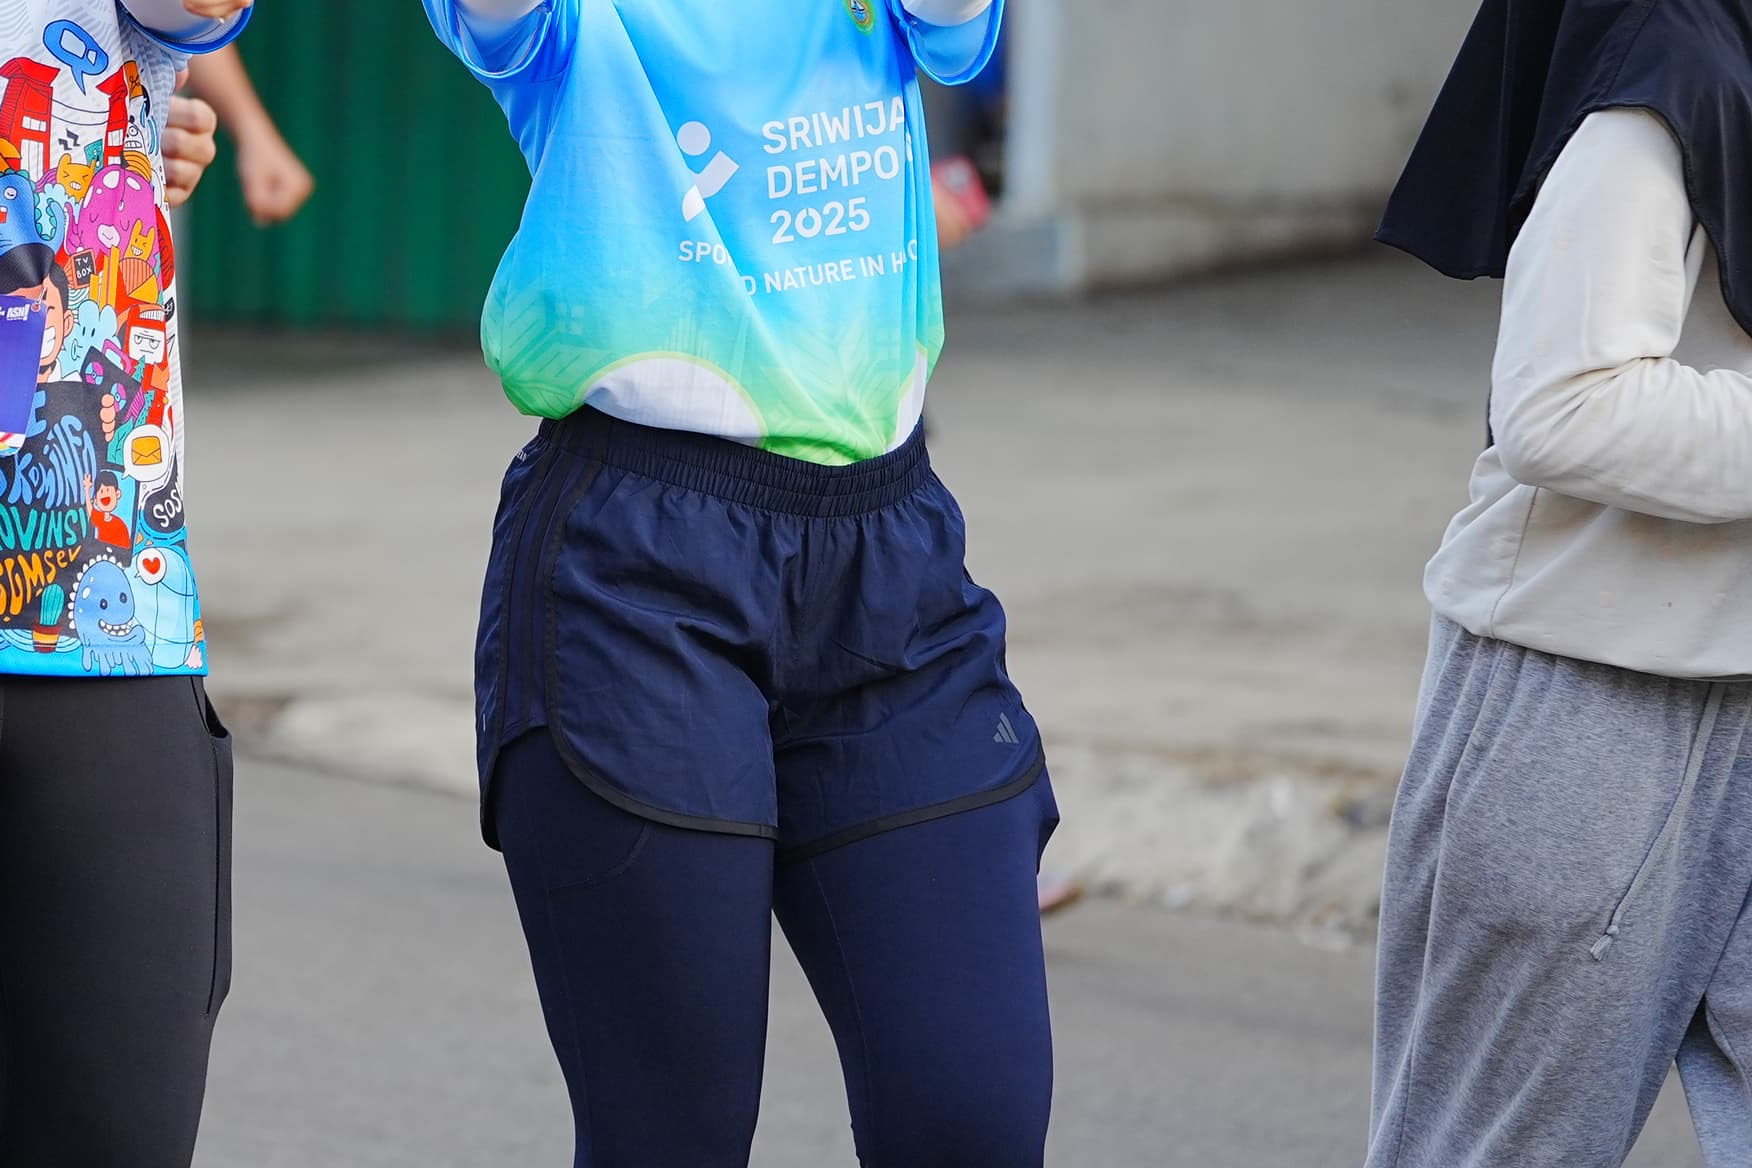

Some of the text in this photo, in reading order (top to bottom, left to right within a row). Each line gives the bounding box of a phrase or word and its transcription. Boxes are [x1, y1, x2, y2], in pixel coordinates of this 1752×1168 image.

[767, 145, 899, 200] DEMPO
[769, 197, 870, 245] 2025
[75, 256, 89, 266] TV
[76, 266, 92, 279] BOX
[763, 259, 857, 294] NATURE
[860, 255, 885, 278] IN
